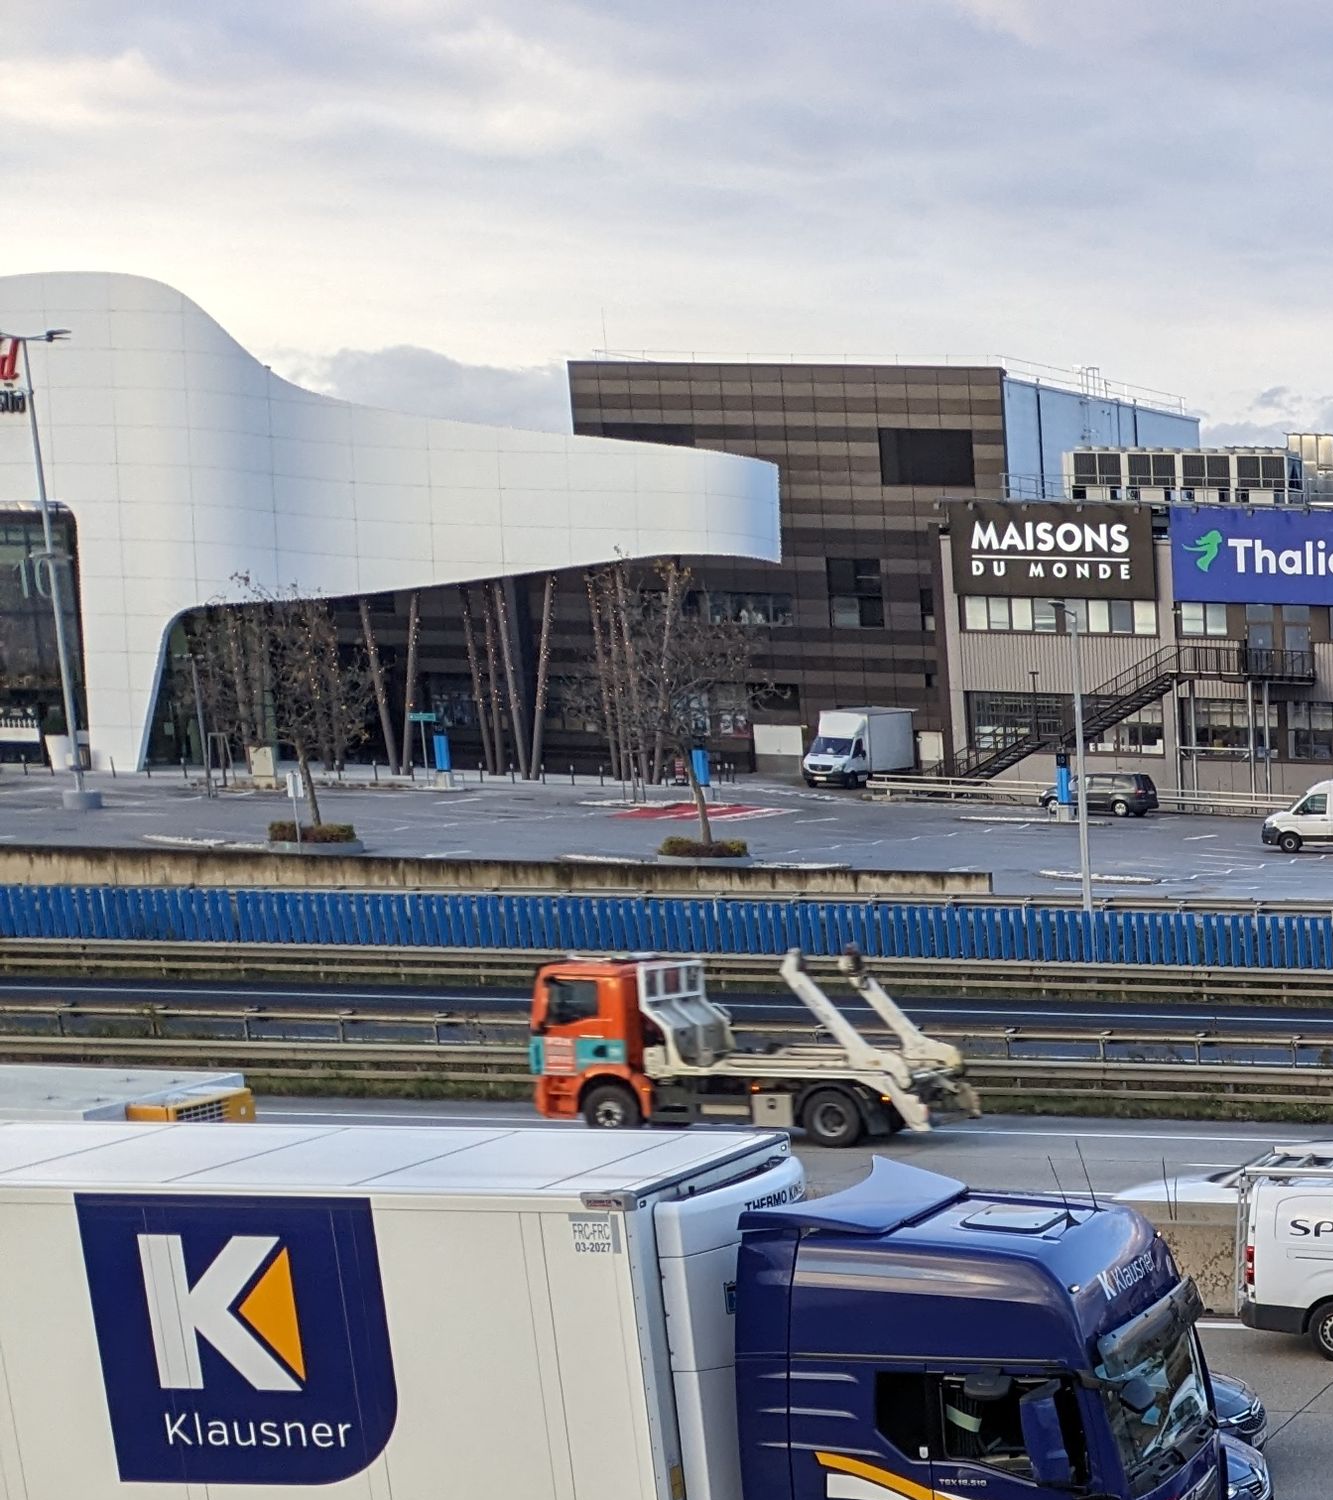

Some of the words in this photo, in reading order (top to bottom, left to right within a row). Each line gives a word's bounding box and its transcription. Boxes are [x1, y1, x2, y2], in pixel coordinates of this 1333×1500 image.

[971, 520, 1130, 554] MAISONS
[971, 561, 1006, 577] DU
[1028, 562, 1131, 580] MONDE
[744, 1189, 787, 1211] THERMO
[571, 1223, 611, 1241] FRC-FRC
[574, 1242, 611, 1253] 03-2027
[1110, 1250, 1156, 1293] Klausner
[137, 1233, 303, 1391] K
[164, 1412, 352, 1448] Klausner
